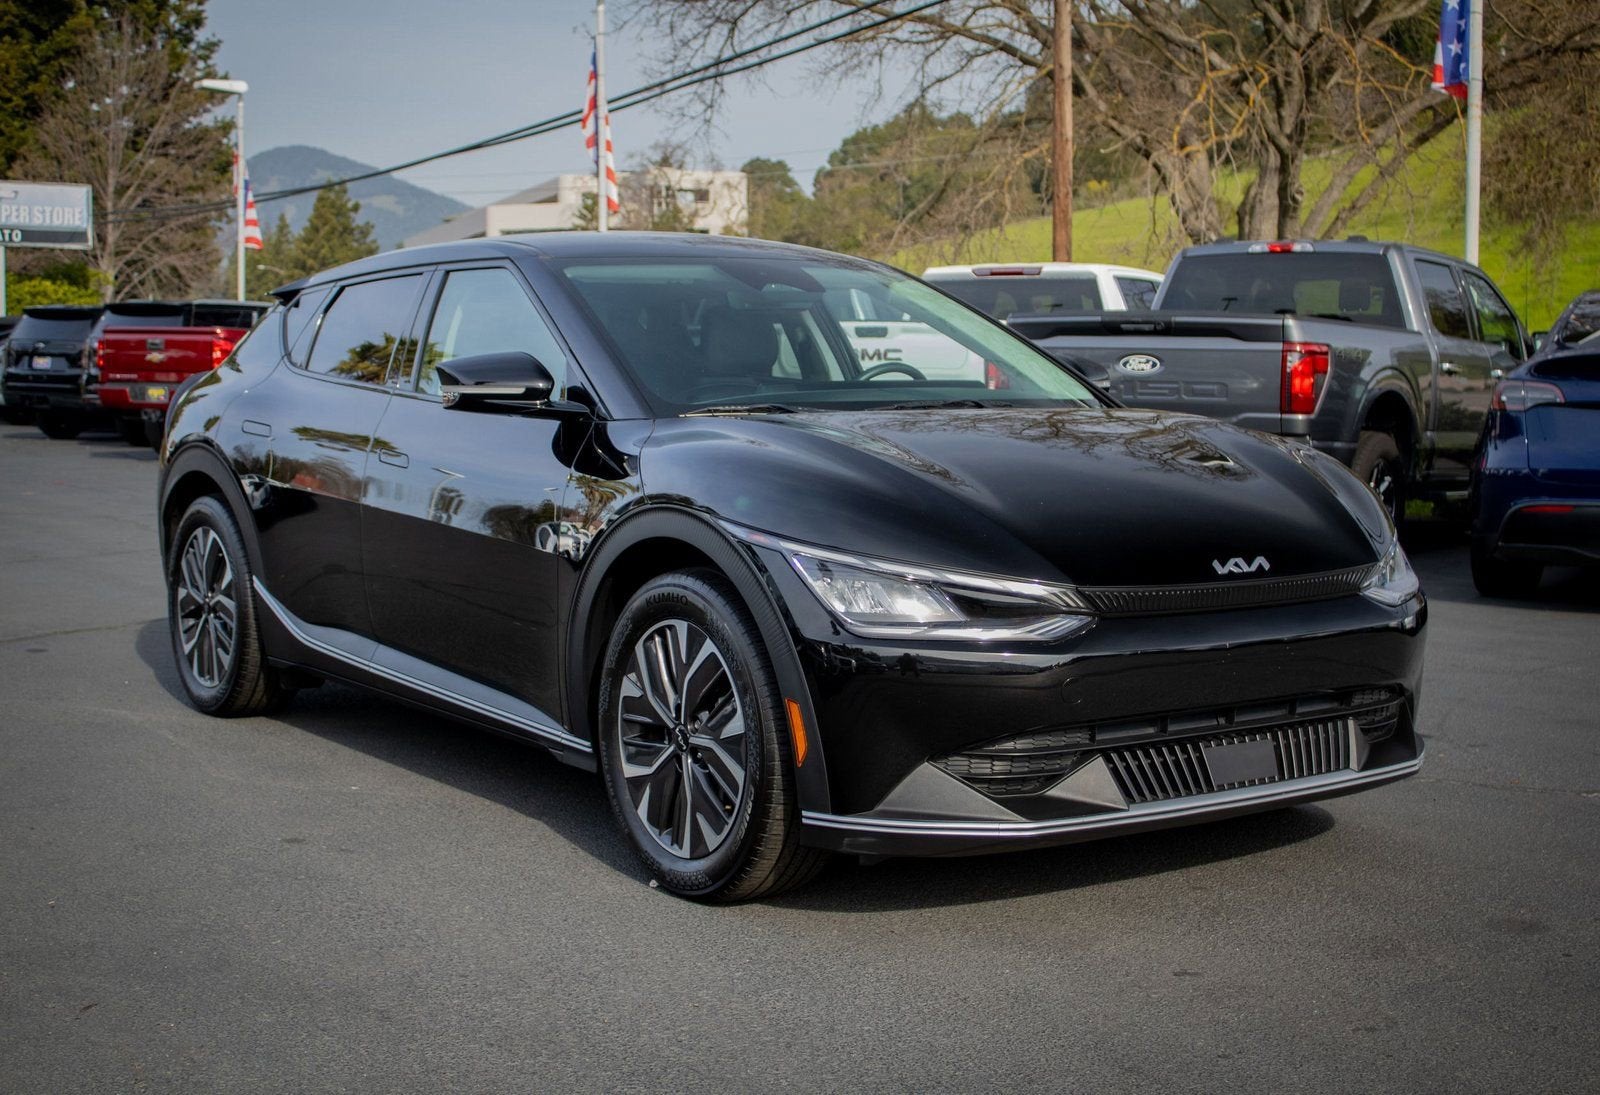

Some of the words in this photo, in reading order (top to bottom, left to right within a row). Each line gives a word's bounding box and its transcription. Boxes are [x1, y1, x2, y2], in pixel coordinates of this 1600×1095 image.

[1, 205, 29, 223] PER
[33, 206, 81, 225] STORE
[854, 348, 903, 361] MC
[1212, 556, 1271, 575] KIA
[645, 592, 688, 607] KUMHO
